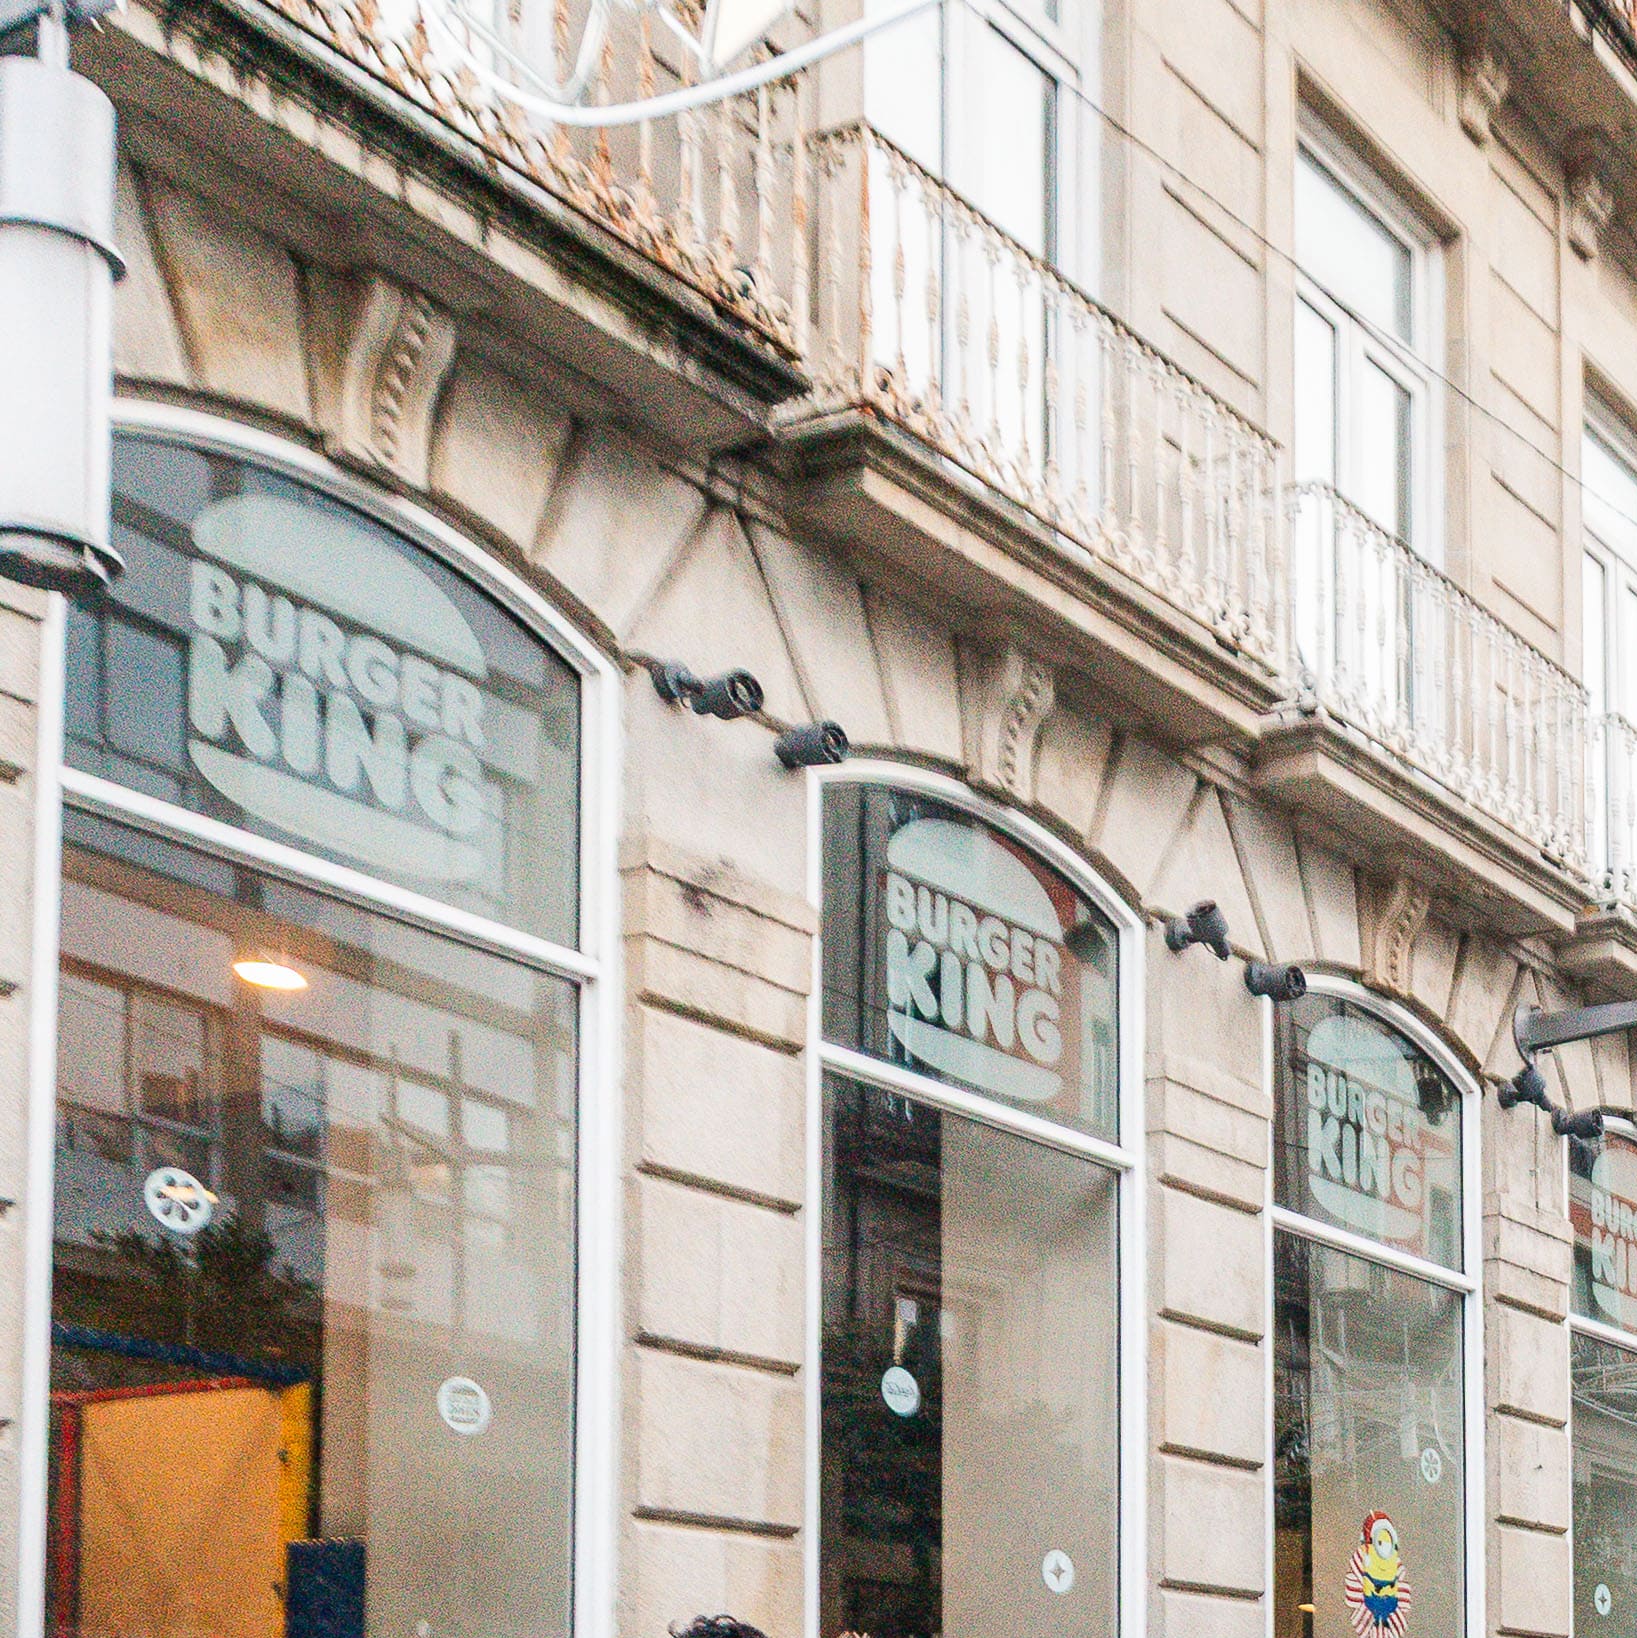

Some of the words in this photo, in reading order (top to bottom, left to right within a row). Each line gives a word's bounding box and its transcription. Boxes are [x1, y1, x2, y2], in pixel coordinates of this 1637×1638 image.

[191, 564, 487, 748] BURGER
[191, 637, 487, 839] KING
[887, 873, 1063, 994] BURGER
[887, 928, 1061, 1065] KING
[1307, 1062, 1422, 1148] BURGER
[1307, 1114, 1423, 1208] KING
